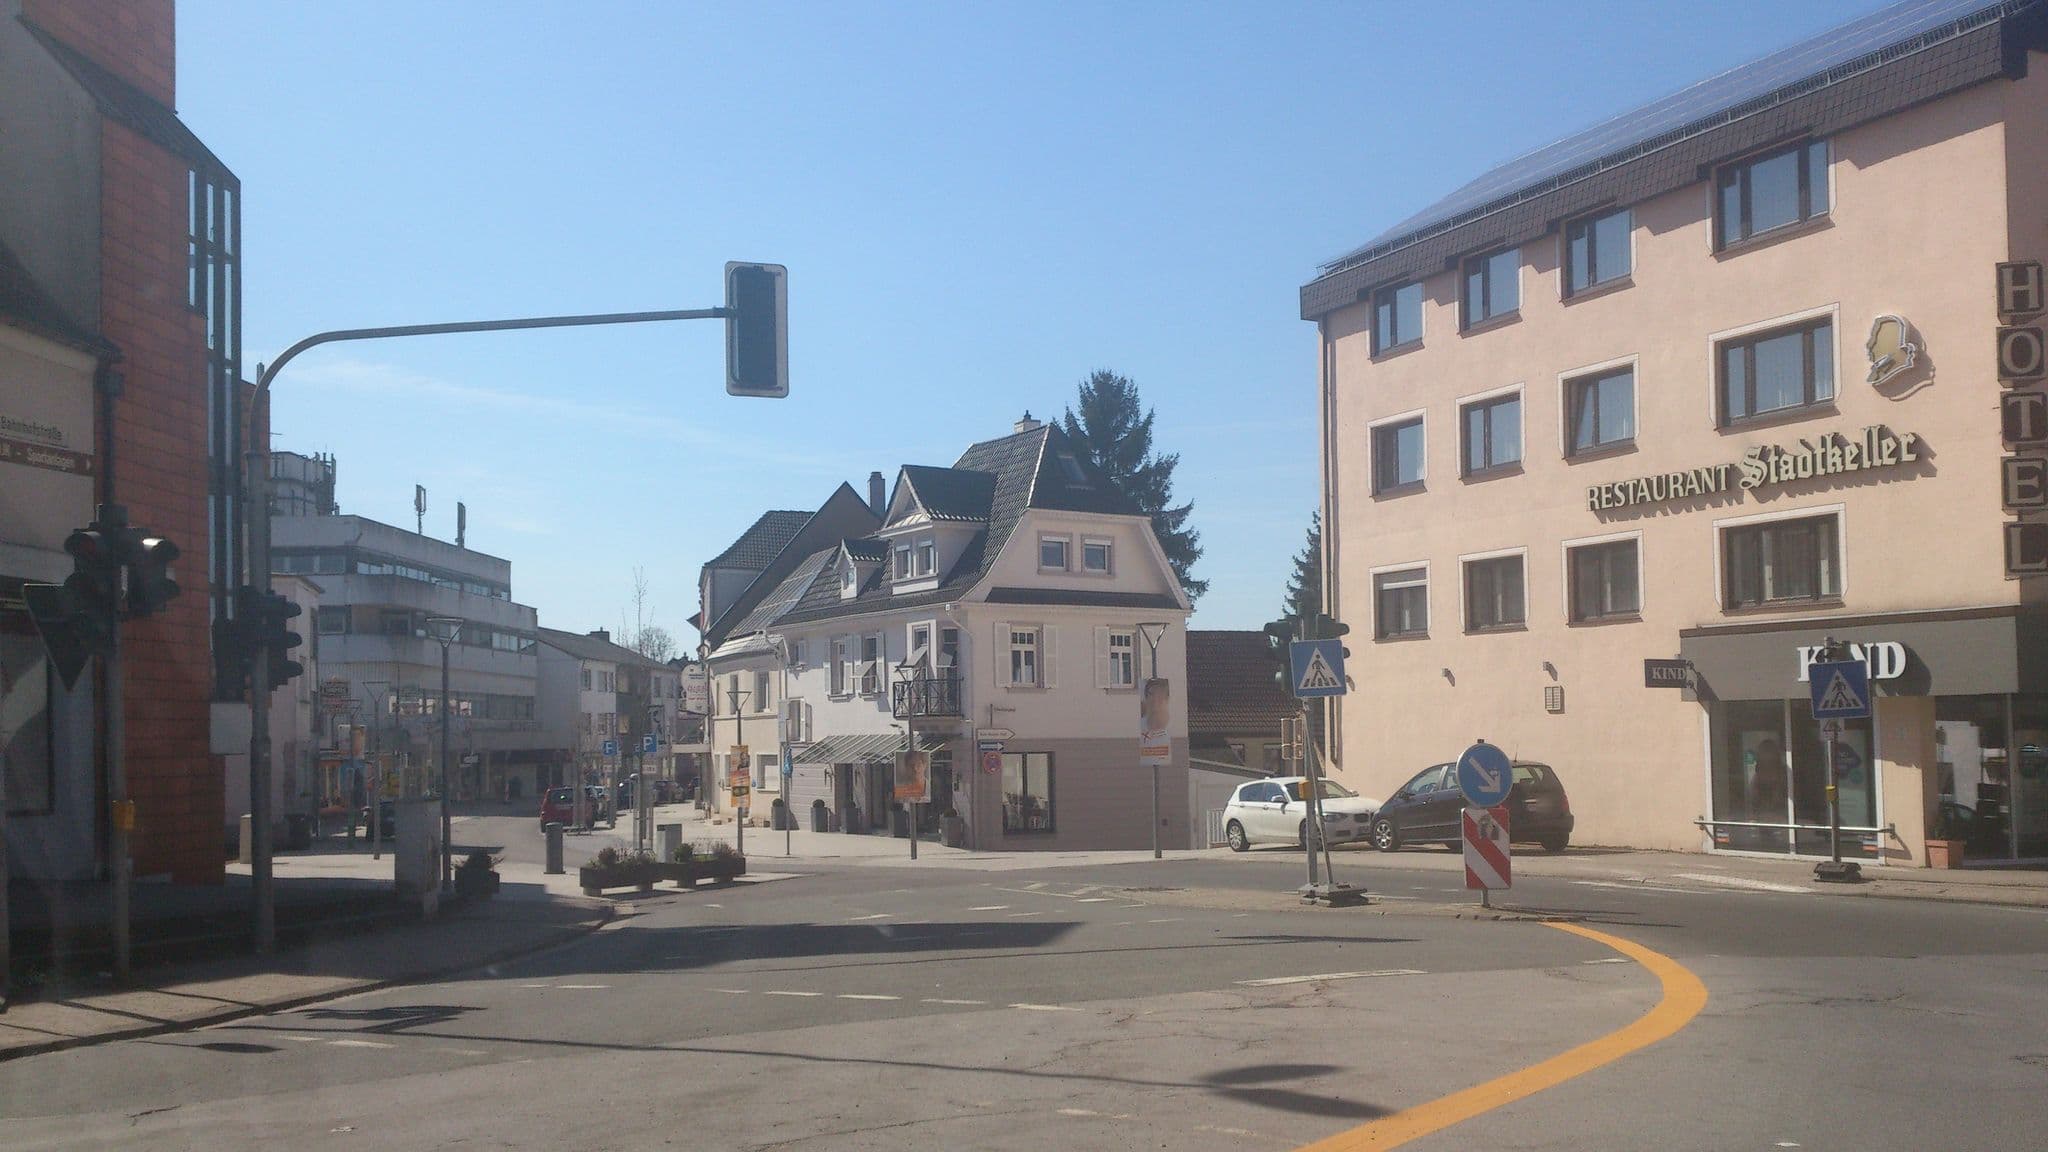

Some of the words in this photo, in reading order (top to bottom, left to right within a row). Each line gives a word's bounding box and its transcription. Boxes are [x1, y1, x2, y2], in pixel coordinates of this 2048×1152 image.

[2001, 265, 2047, 571] HOTEL
[1587, 464, 1730, 511] RESTAURANT
[1739, 424, 1917, 490] Stadtkeller
[1652, 666, 1686, 680] KIND
[1797, 641, 1906, 682] KND
